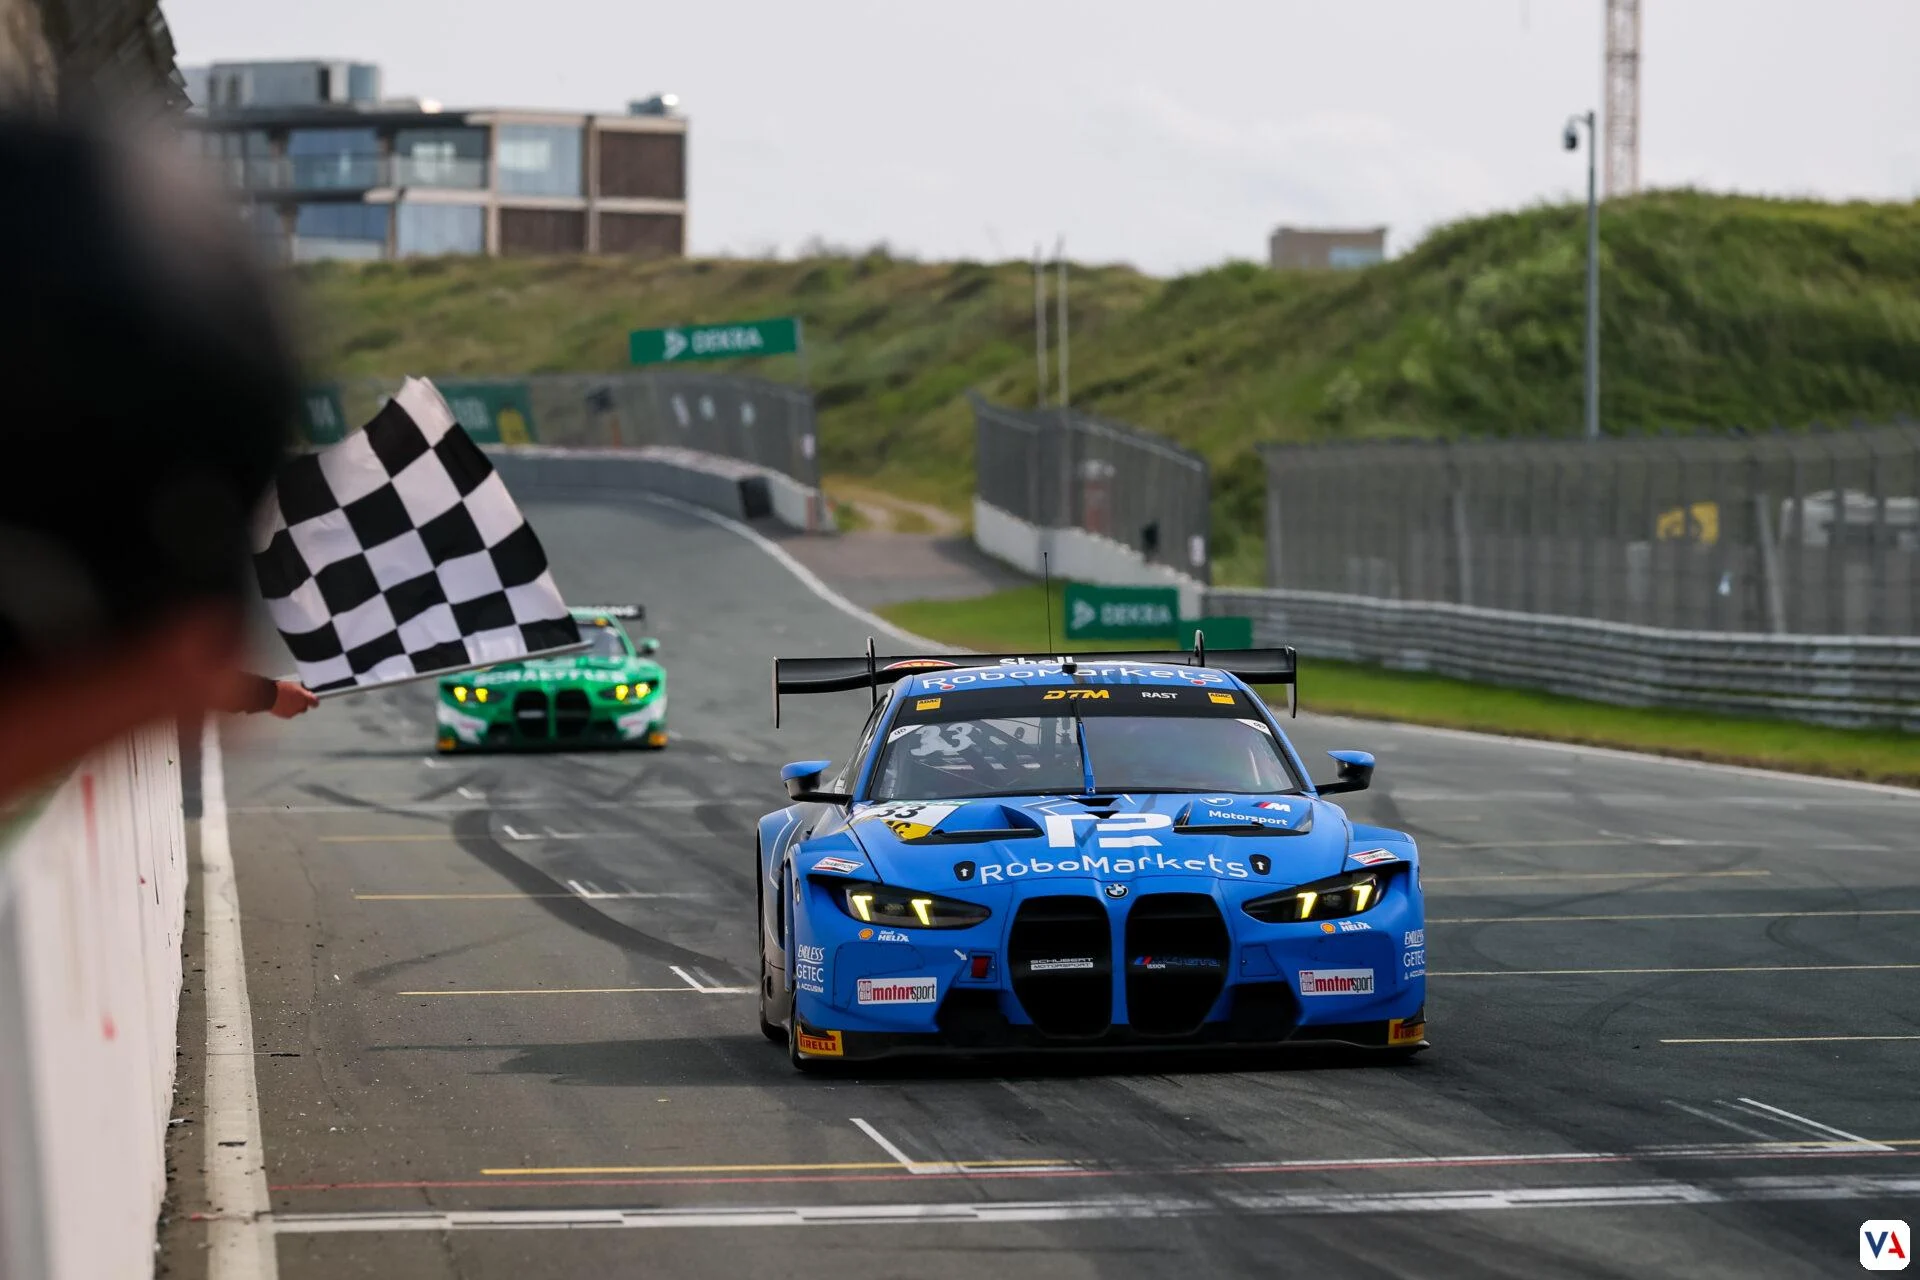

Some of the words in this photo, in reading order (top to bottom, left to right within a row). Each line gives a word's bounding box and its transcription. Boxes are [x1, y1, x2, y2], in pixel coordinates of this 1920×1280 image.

[1100, 603, 1172, 627] DEKRA
[922, 667, 1224, 690] RoboMarkets
[1042, 689, 1110, 700] DTM
[1141, 691, 1178, 699] RAST
[1208, 810, 1288, 826] Motorsport
[980, 853, 1249, 885] RoboMarkets
[878, 933, 909, 942] HELIX
[798, 944, 825, 961] ENDLESS
[797, 963, 824, 983] GETEC
[873, 984, 936, 1002] motorsport
[1315, 975, 1373, 993] motorsport
